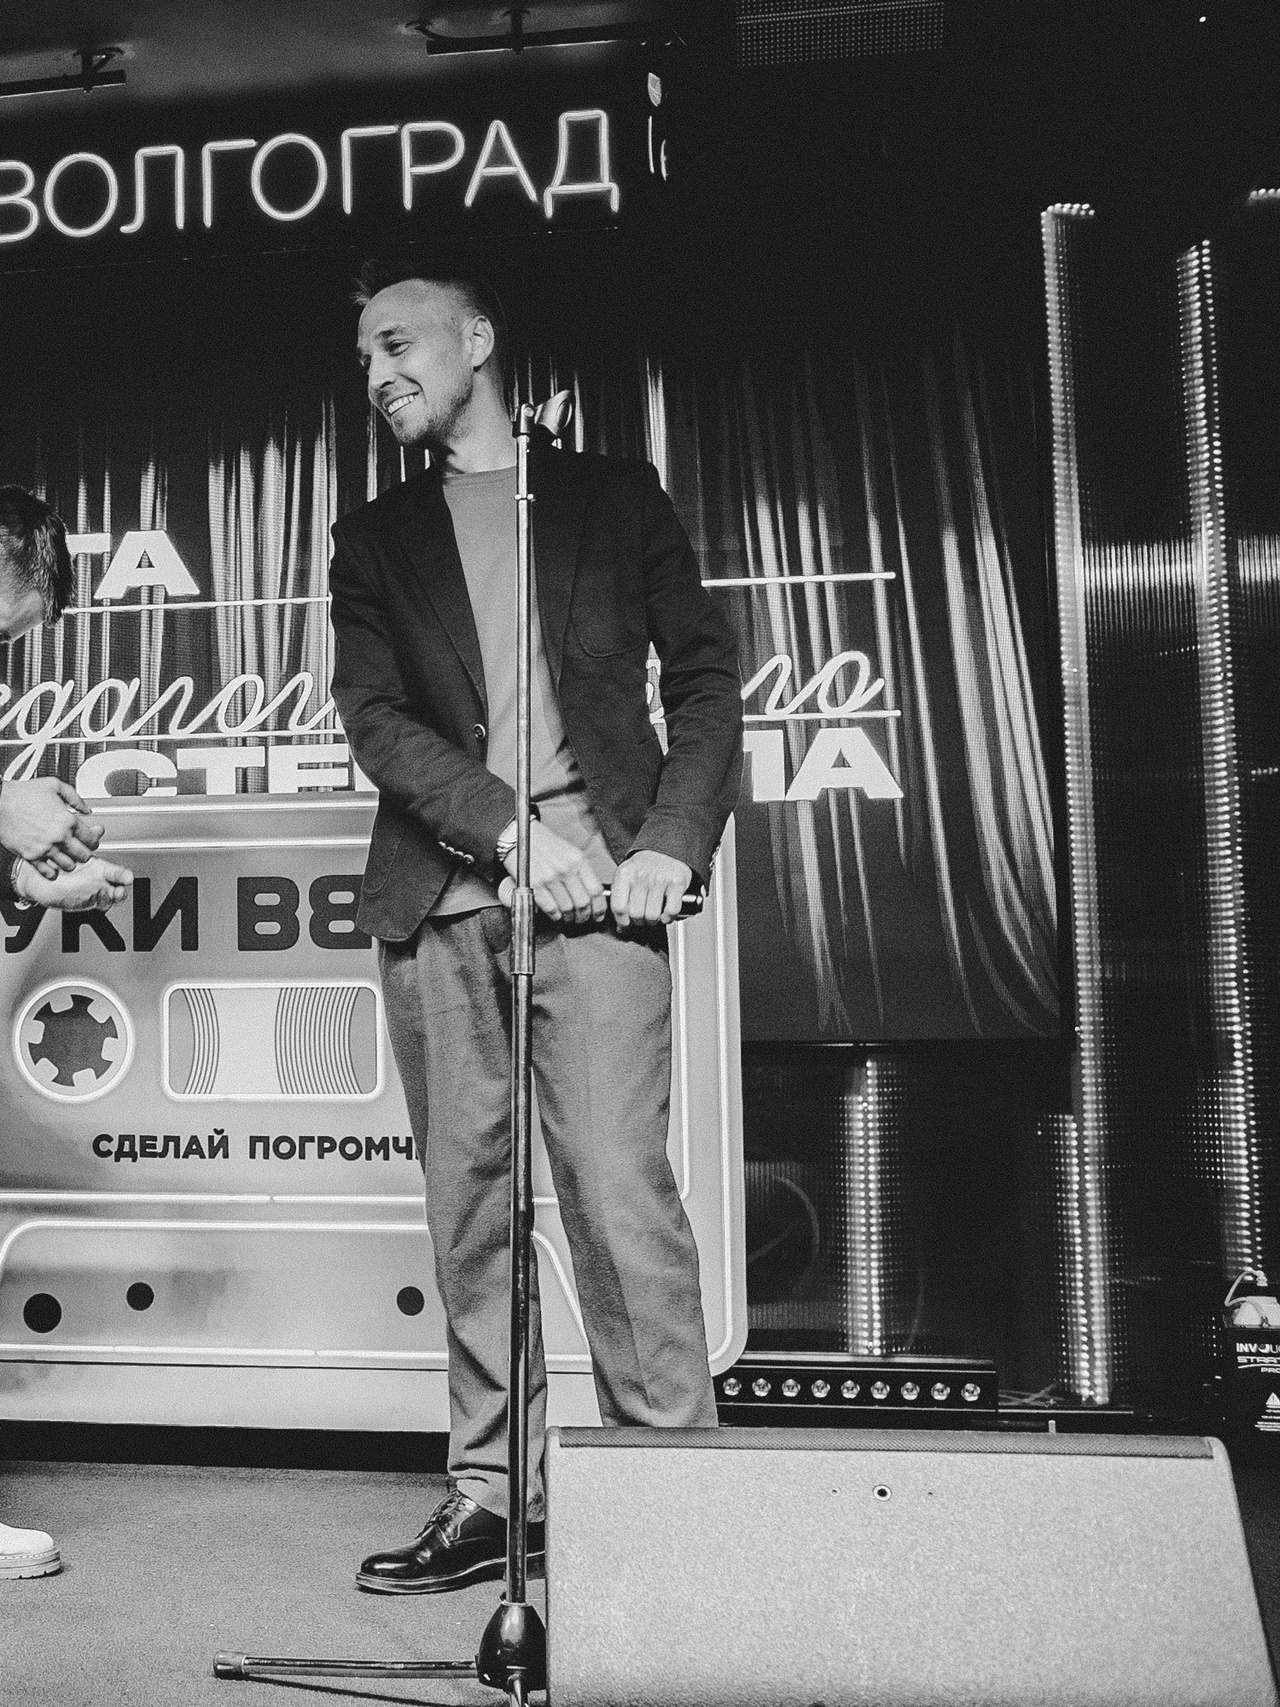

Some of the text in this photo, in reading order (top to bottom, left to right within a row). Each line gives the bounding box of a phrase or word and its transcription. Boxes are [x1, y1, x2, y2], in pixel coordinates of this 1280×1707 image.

[76, 743, 380, 799] СТЕ
[92, 1128, 419, 1162] СДЕЛАЙ ПОГРОМЧ
